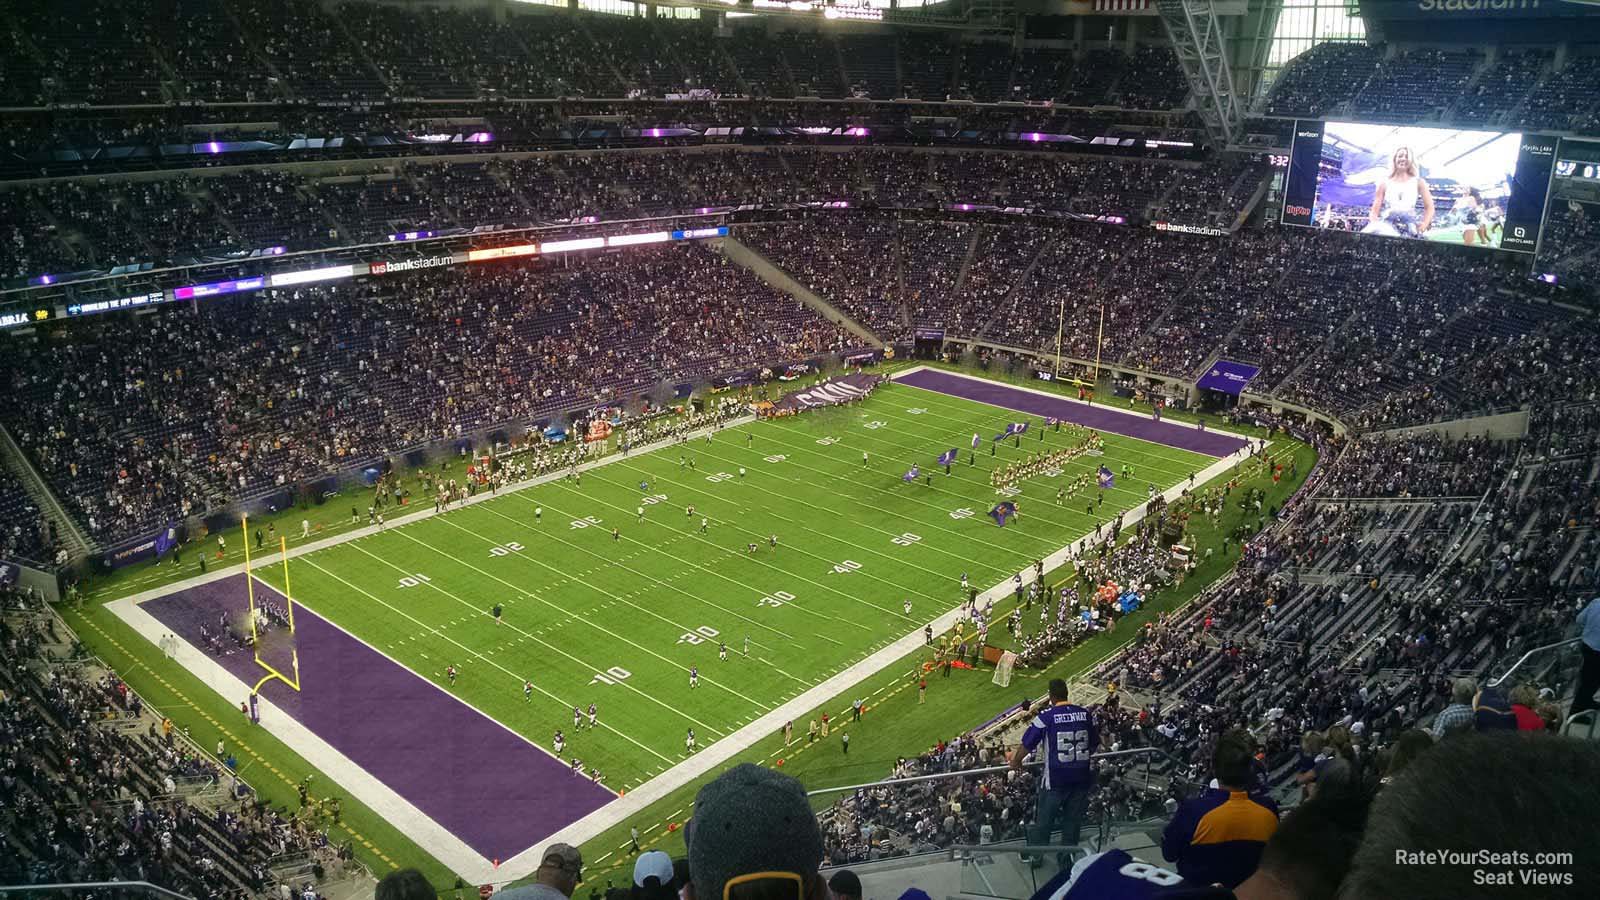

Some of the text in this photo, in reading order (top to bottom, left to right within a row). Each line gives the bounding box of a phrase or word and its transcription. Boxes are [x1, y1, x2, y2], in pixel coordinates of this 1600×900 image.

[1269, 155, 1289, 166] 7:32
[0, 312, 29, 327] BRIA
[891, 532, 922, 546] 50
[489, 542, 525, 556] 20
[833, 559, 863, 575] 40
[760, 590, 796, 608] 30
[679, 625, 720, 645] 20
[594, 666, 632, 686] 10
[1053, 711, 1088, 725] GREENWAY
[1056, 729, 1090, 763] 52
